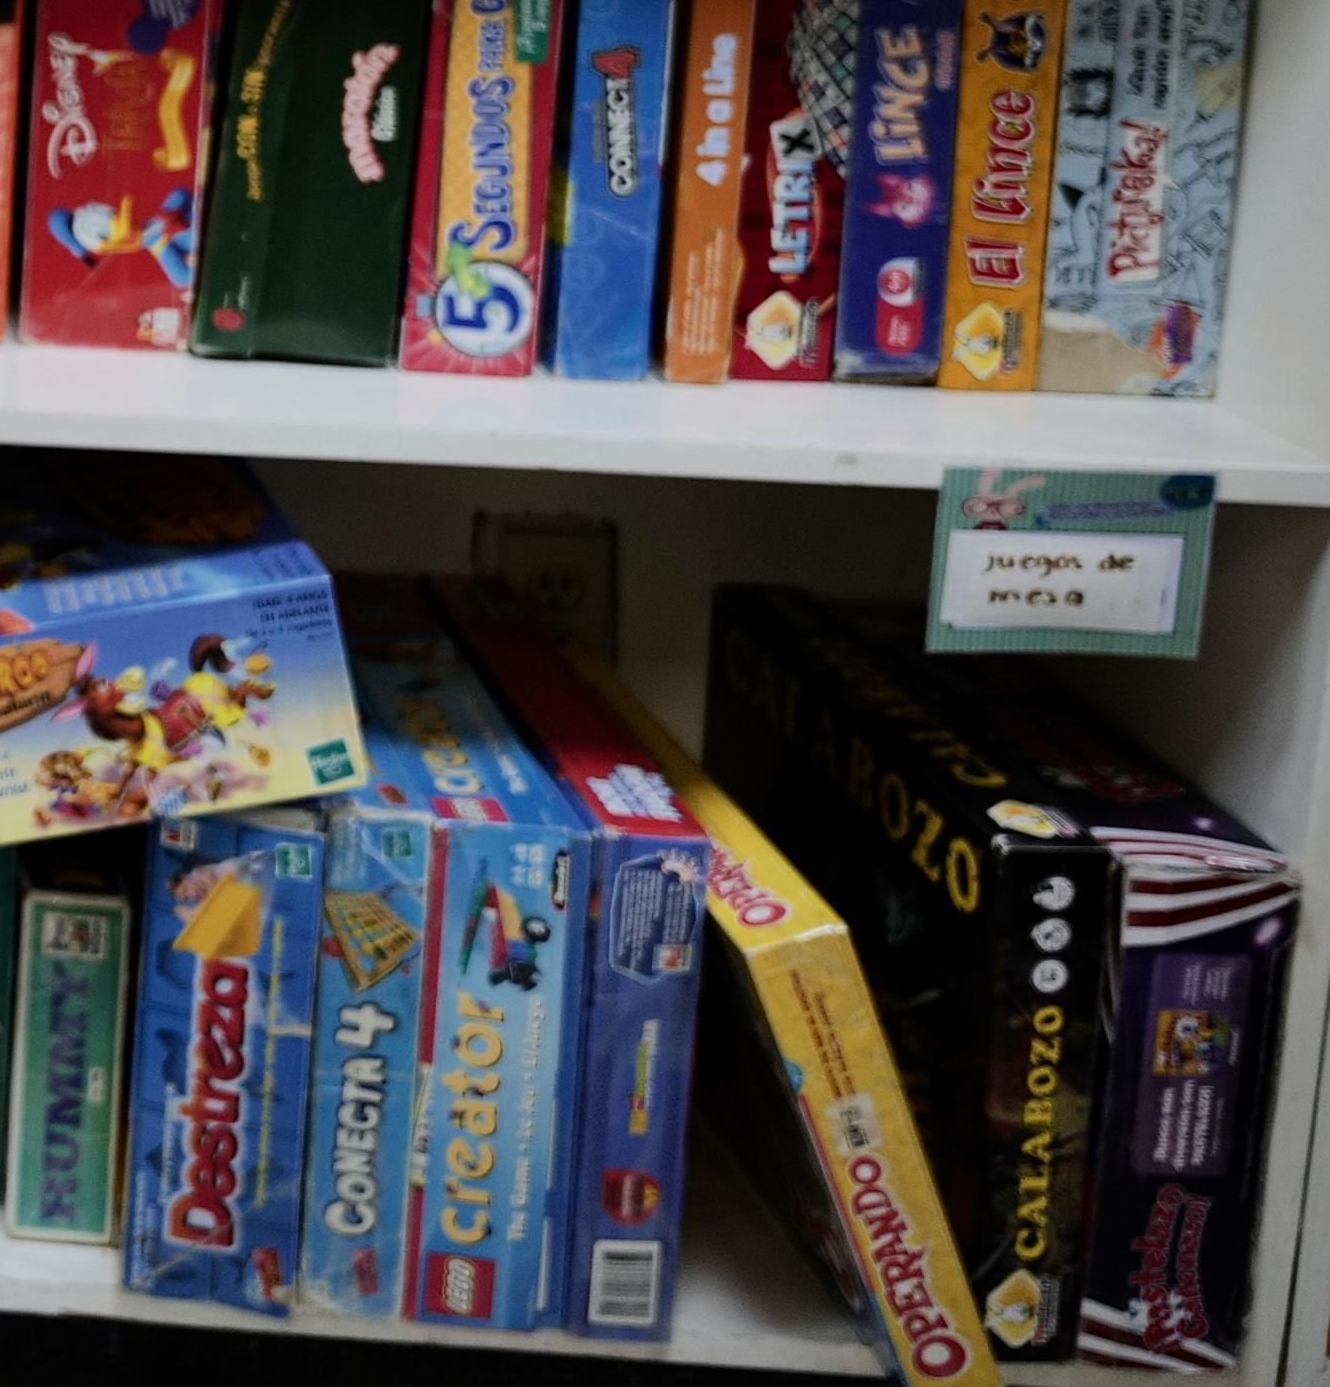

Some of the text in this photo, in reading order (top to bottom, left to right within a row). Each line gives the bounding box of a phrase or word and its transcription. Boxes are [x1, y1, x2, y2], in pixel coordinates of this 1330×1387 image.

[42, 32, 100, 181] Disney
[592, 47, 639, 195] CONNECT 4
[702, 32, 738, 97] Line
[707, 99, 733, 124] a
[446, 75, 515, 253] SEGUNDOS
[695, 127, 731, 157] in
[696, 160, 728, 186] 4
[768, 118, 823, 277] LETRIX
[964, 88, 1035, 290] El Lince
[441, 288, 522, 334] 5
[987, 588, 1087, 607] mesa
[1097, 552, 1136, 572] de
[37, 960, 92, 1223] RUMMY
[166, 955, 250, 1250] Destreza
[322, 1002, 398, 1238] CONECTA 4
[438, 990, 506, 1247] creator
[1012, 1003, 1067, 1262] CALABOZO
[442, 1255, 478, 1316] LEGO
[506, 1212, 527, 1242] The
[848, 1154, 968, 1381] OPERANDO
